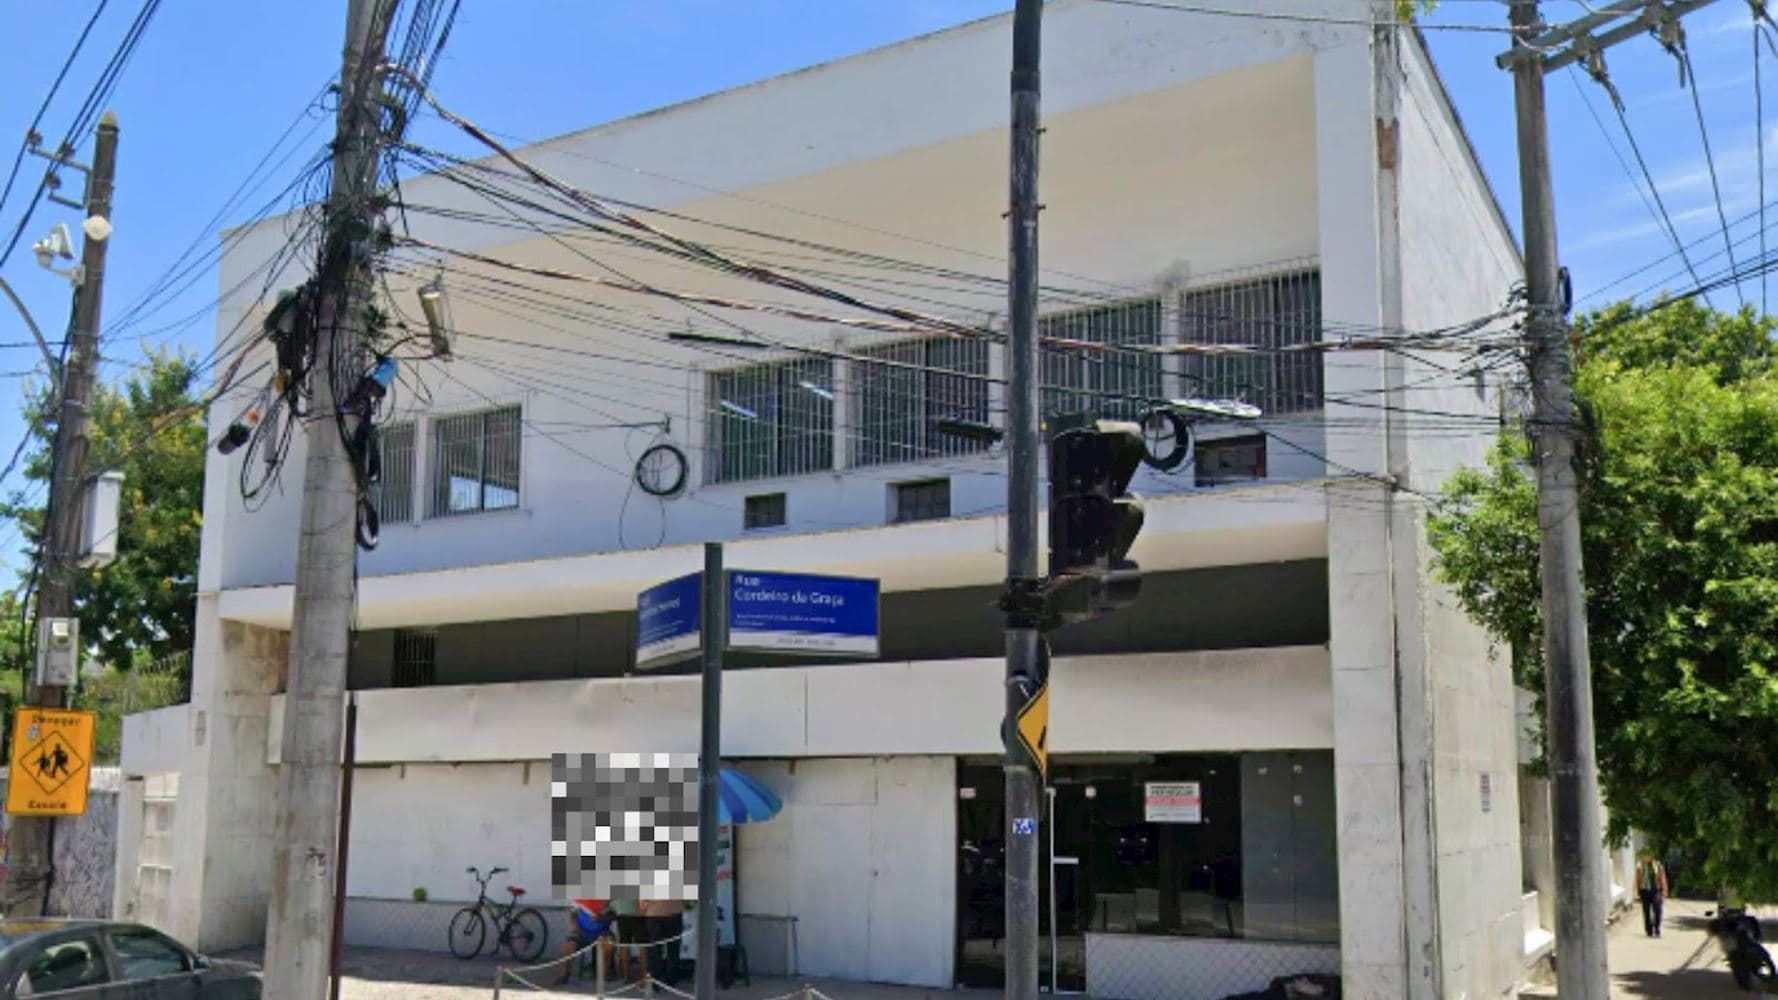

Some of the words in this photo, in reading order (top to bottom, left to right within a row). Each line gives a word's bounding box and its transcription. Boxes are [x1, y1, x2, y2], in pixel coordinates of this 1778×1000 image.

[735, 575, 760, 586] Rua
[734, 587, 789, 602] Cordeiro
[792, 591, 808, 604] da
[809, 592, 844, 607] Graça
